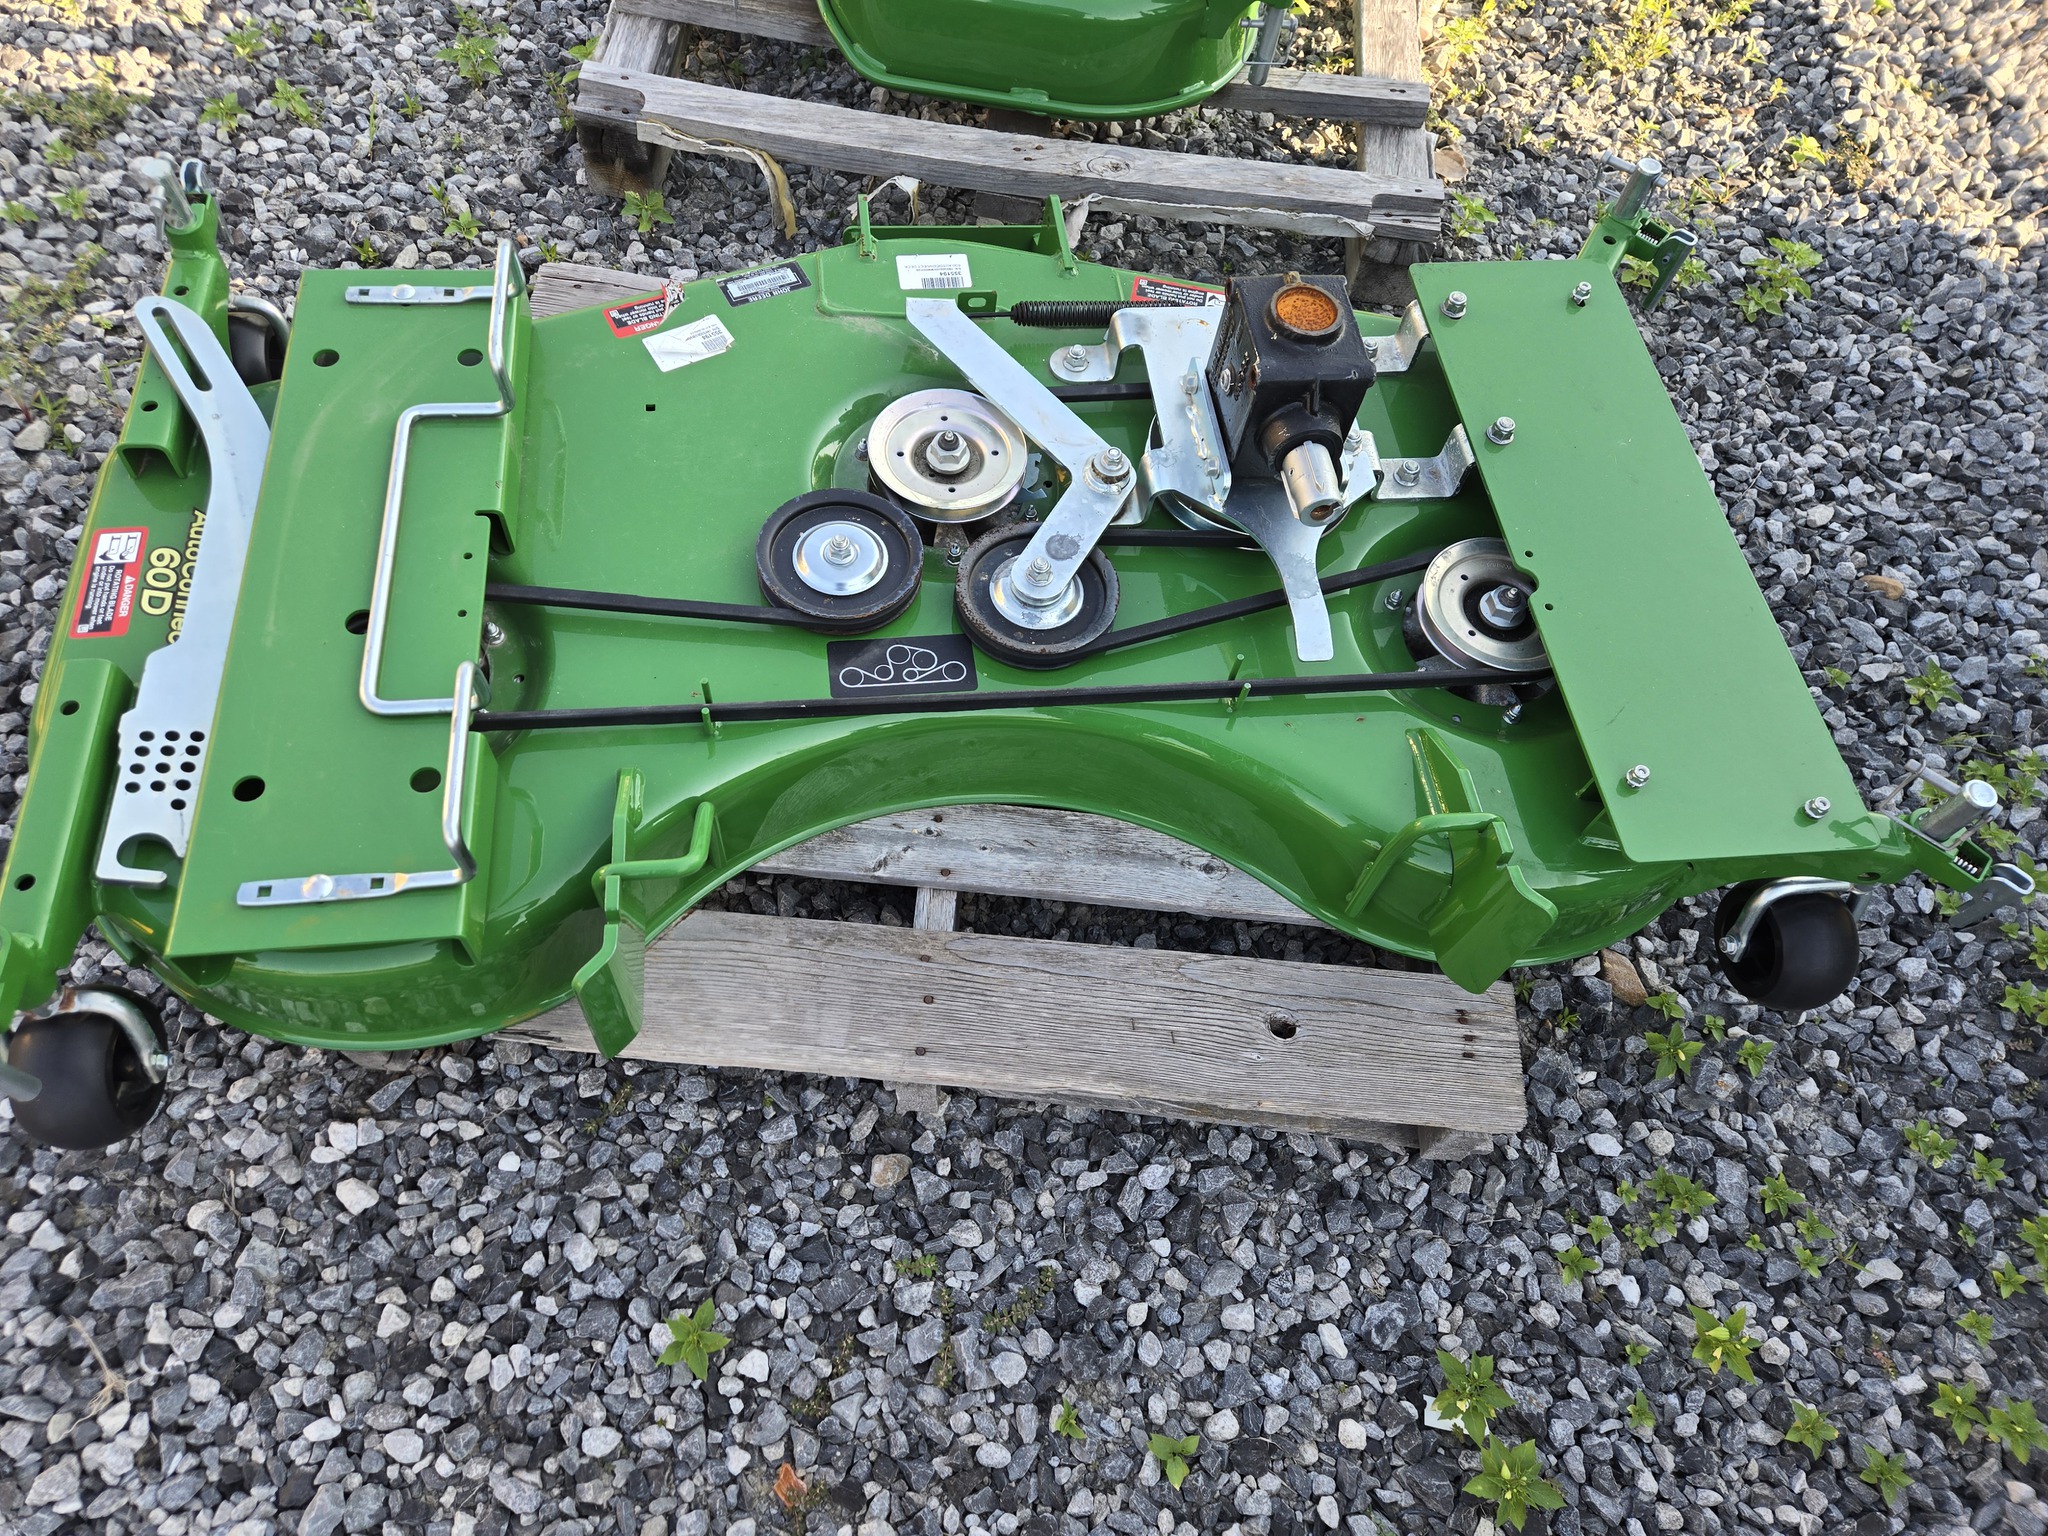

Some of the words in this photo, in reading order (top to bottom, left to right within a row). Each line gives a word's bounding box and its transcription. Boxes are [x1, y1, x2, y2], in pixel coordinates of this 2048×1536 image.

[747, 292, 771, 302] DEERE
[771, 286, 791, 296] JOHN
[1147, 292, 1167, 301] BLADE
[638, 309, 655, 318] hands
[648, 311, 665, 320] TING
[626, 315, 648, 326] BLADE
[633, 320, 660, 332] NGER
[92, 566, 101, 581] engine
[99, 566, 108, 580] under
[166, 510, 207, 644] AutoConnec
[103, 583, 111, 591] put
[109, 570, 123, 599] ROTATING
[139, 547, 181, 616] 60D
[85, 589, 95, 608] running
[100, 592, 109, 607] hands
[118, 585, 134, 617] DANGER
[92, 598, 100, 614] mower
[104, 601, 116, 621] BLADE
[88, 616, 96, 629] when
[96, 615, 104, 624] feet
